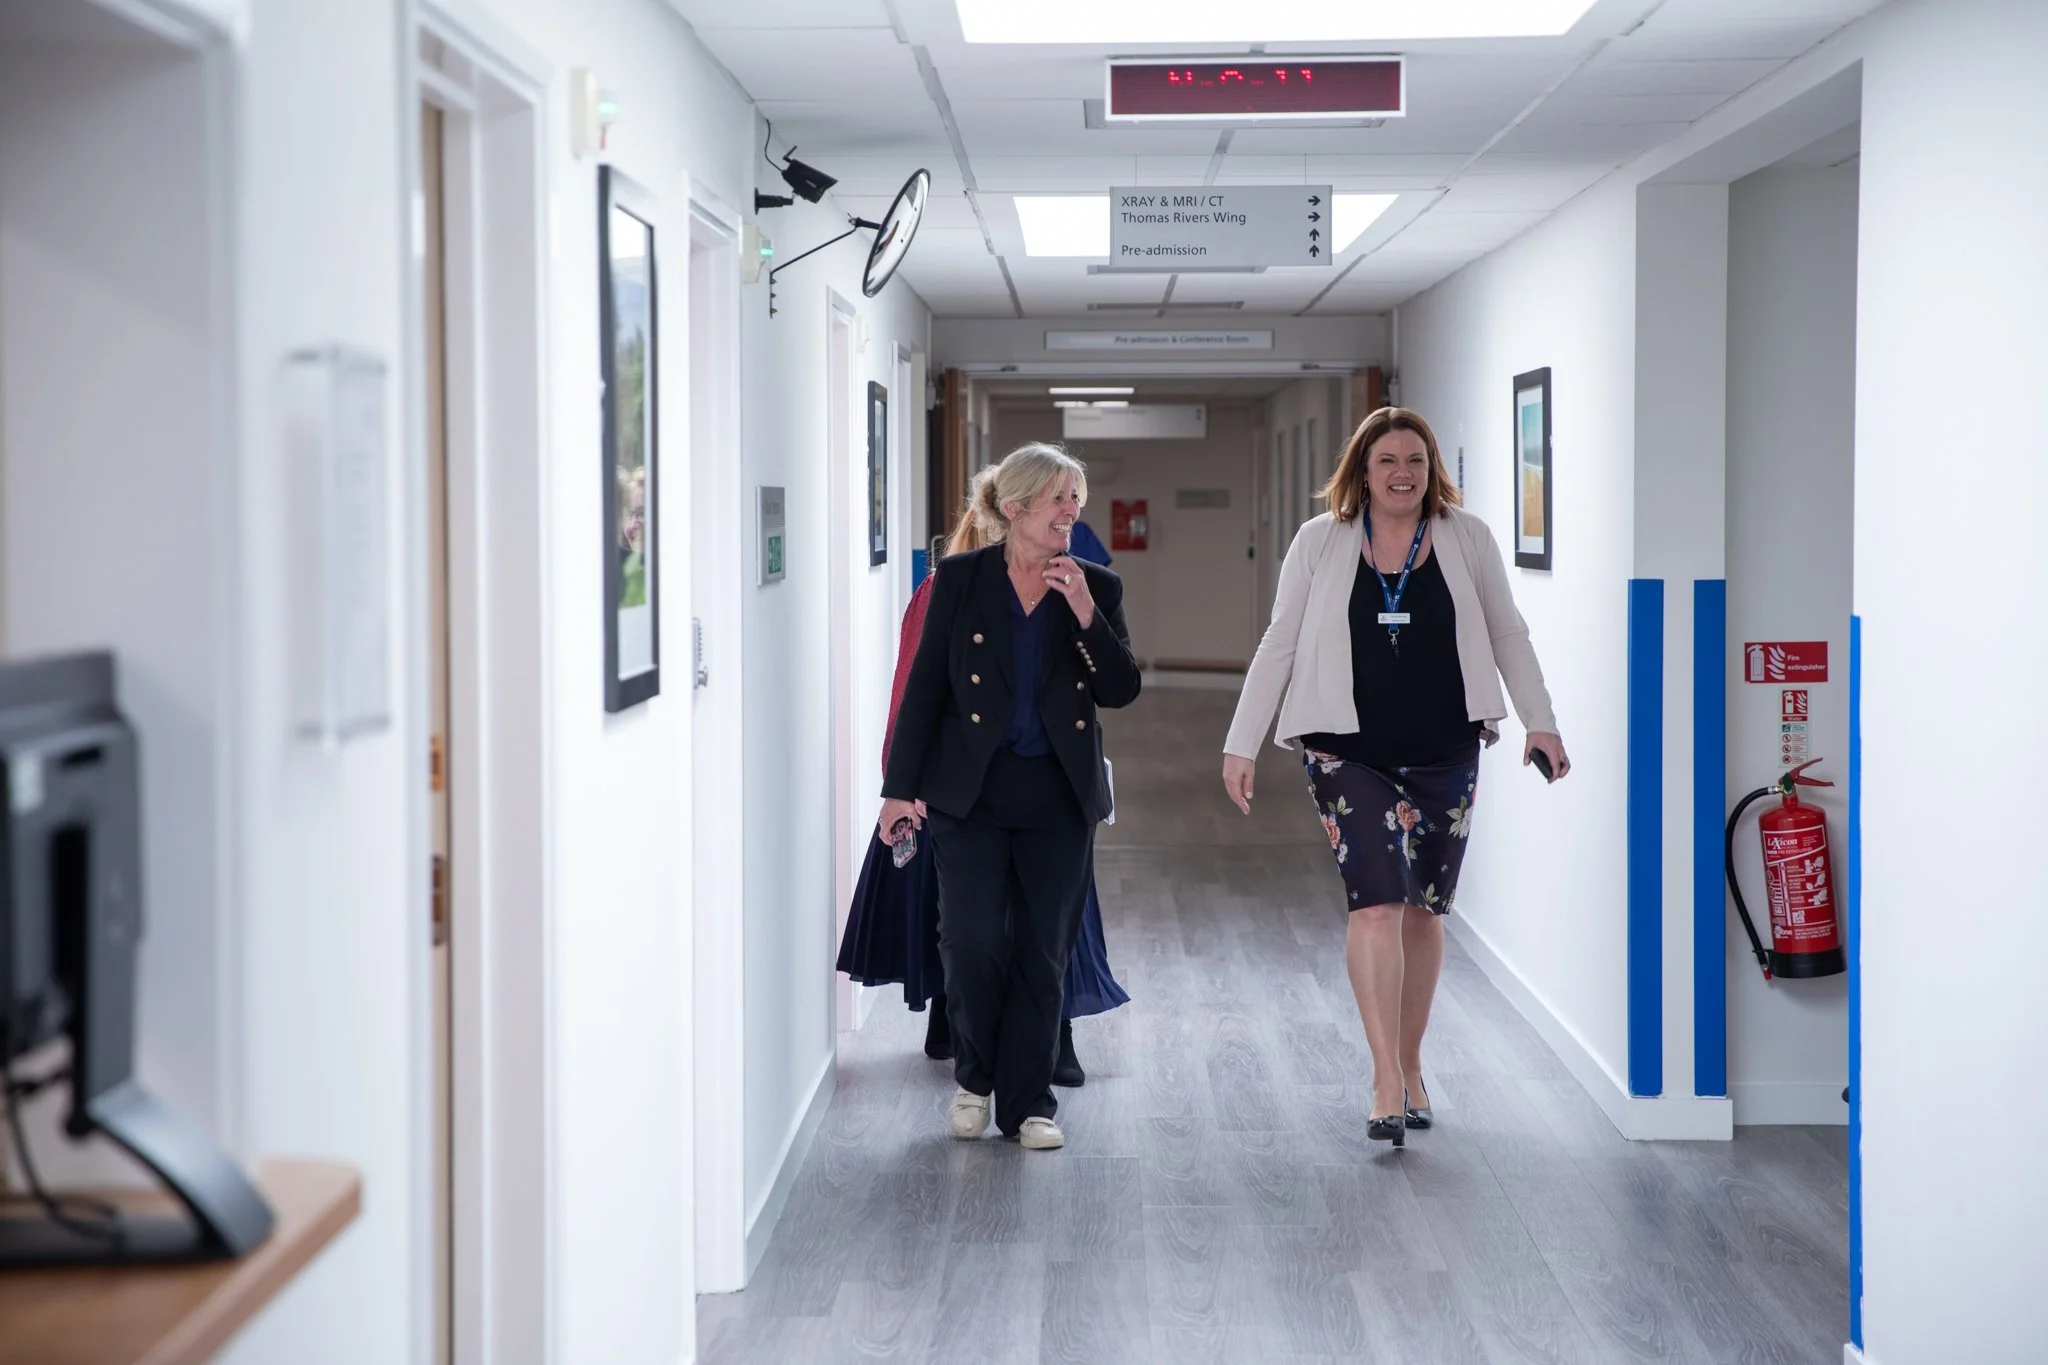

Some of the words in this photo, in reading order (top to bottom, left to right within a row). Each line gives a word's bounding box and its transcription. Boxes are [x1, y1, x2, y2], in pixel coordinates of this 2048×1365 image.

[1121, 196, 1155, 207] XRAY
[1161, 196, 1169, 207] &
[1173, 196, 1197, 207] MRI
[1200, 196, 1205, 207] /
[1208, 196, 1224, 207] CT
[1121, 212, 1169, 223] Thomas
[1173, 212, 1210, 223] Rivers
[1213, 212, 1246, 226] Wing
[1121, 244, 1207, 256] Pre-admission
[1115, 335, 1169, 344] Pre-admission
[1170, 335, 1178, 344] &
[1179, 335, 1224, 344] Conference
[1226, 335, 1250, 344] Room
